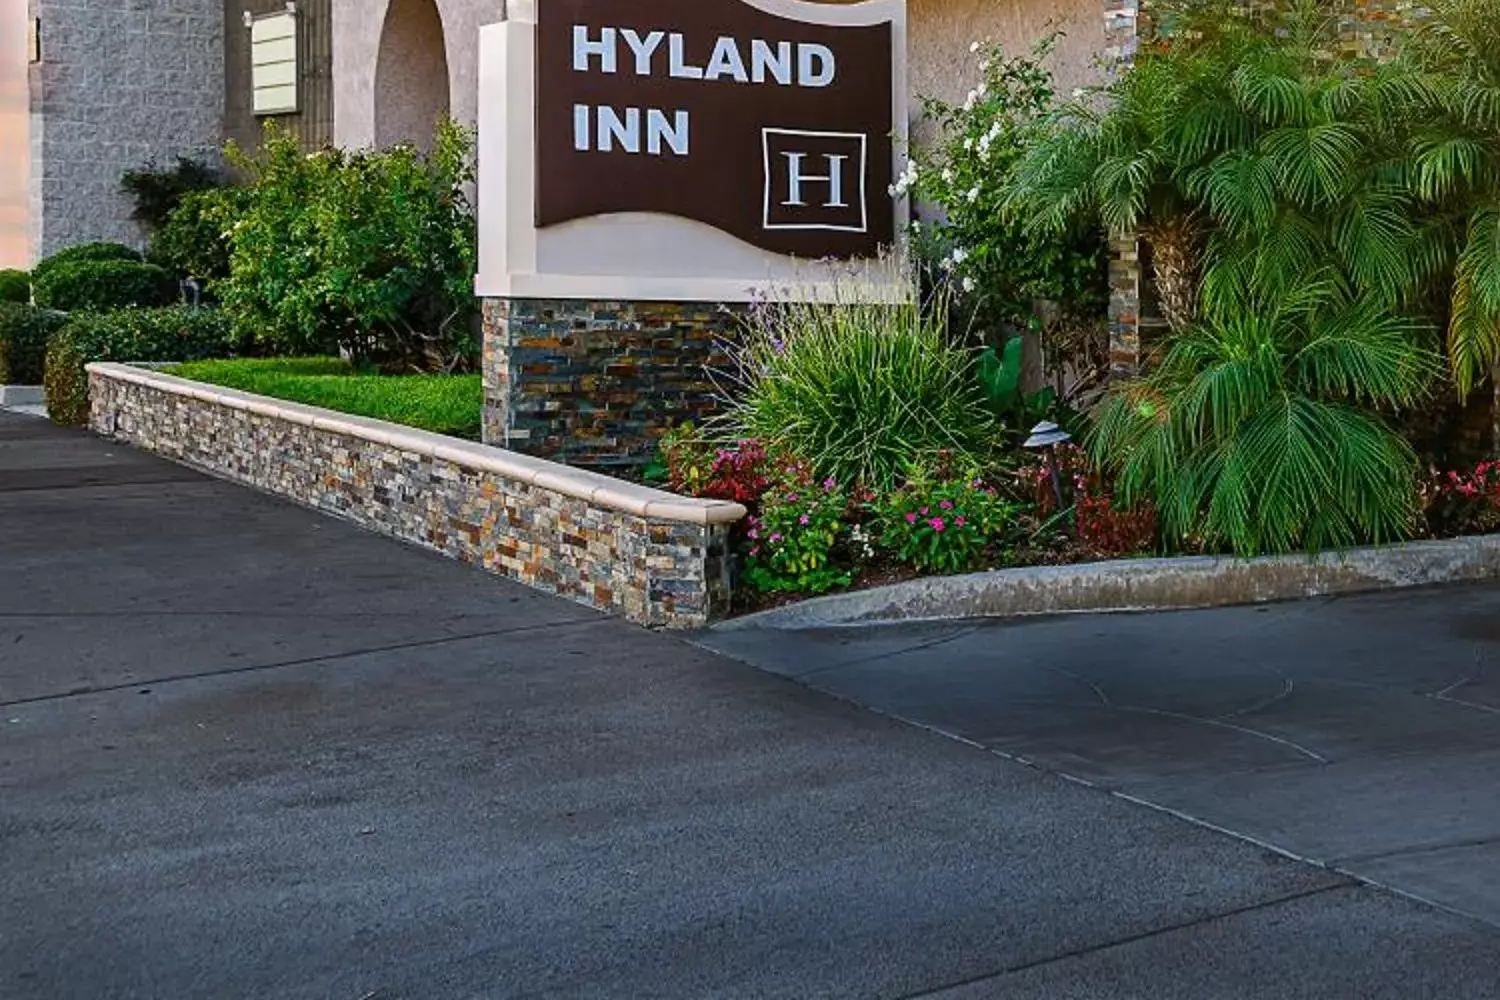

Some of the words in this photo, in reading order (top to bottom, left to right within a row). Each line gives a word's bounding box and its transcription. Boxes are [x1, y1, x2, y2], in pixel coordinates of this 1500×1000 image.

[572, 24, 836, 88] HYLAND
[573, 103, 690, 156] INN
[780, 151, 849, 208] H
